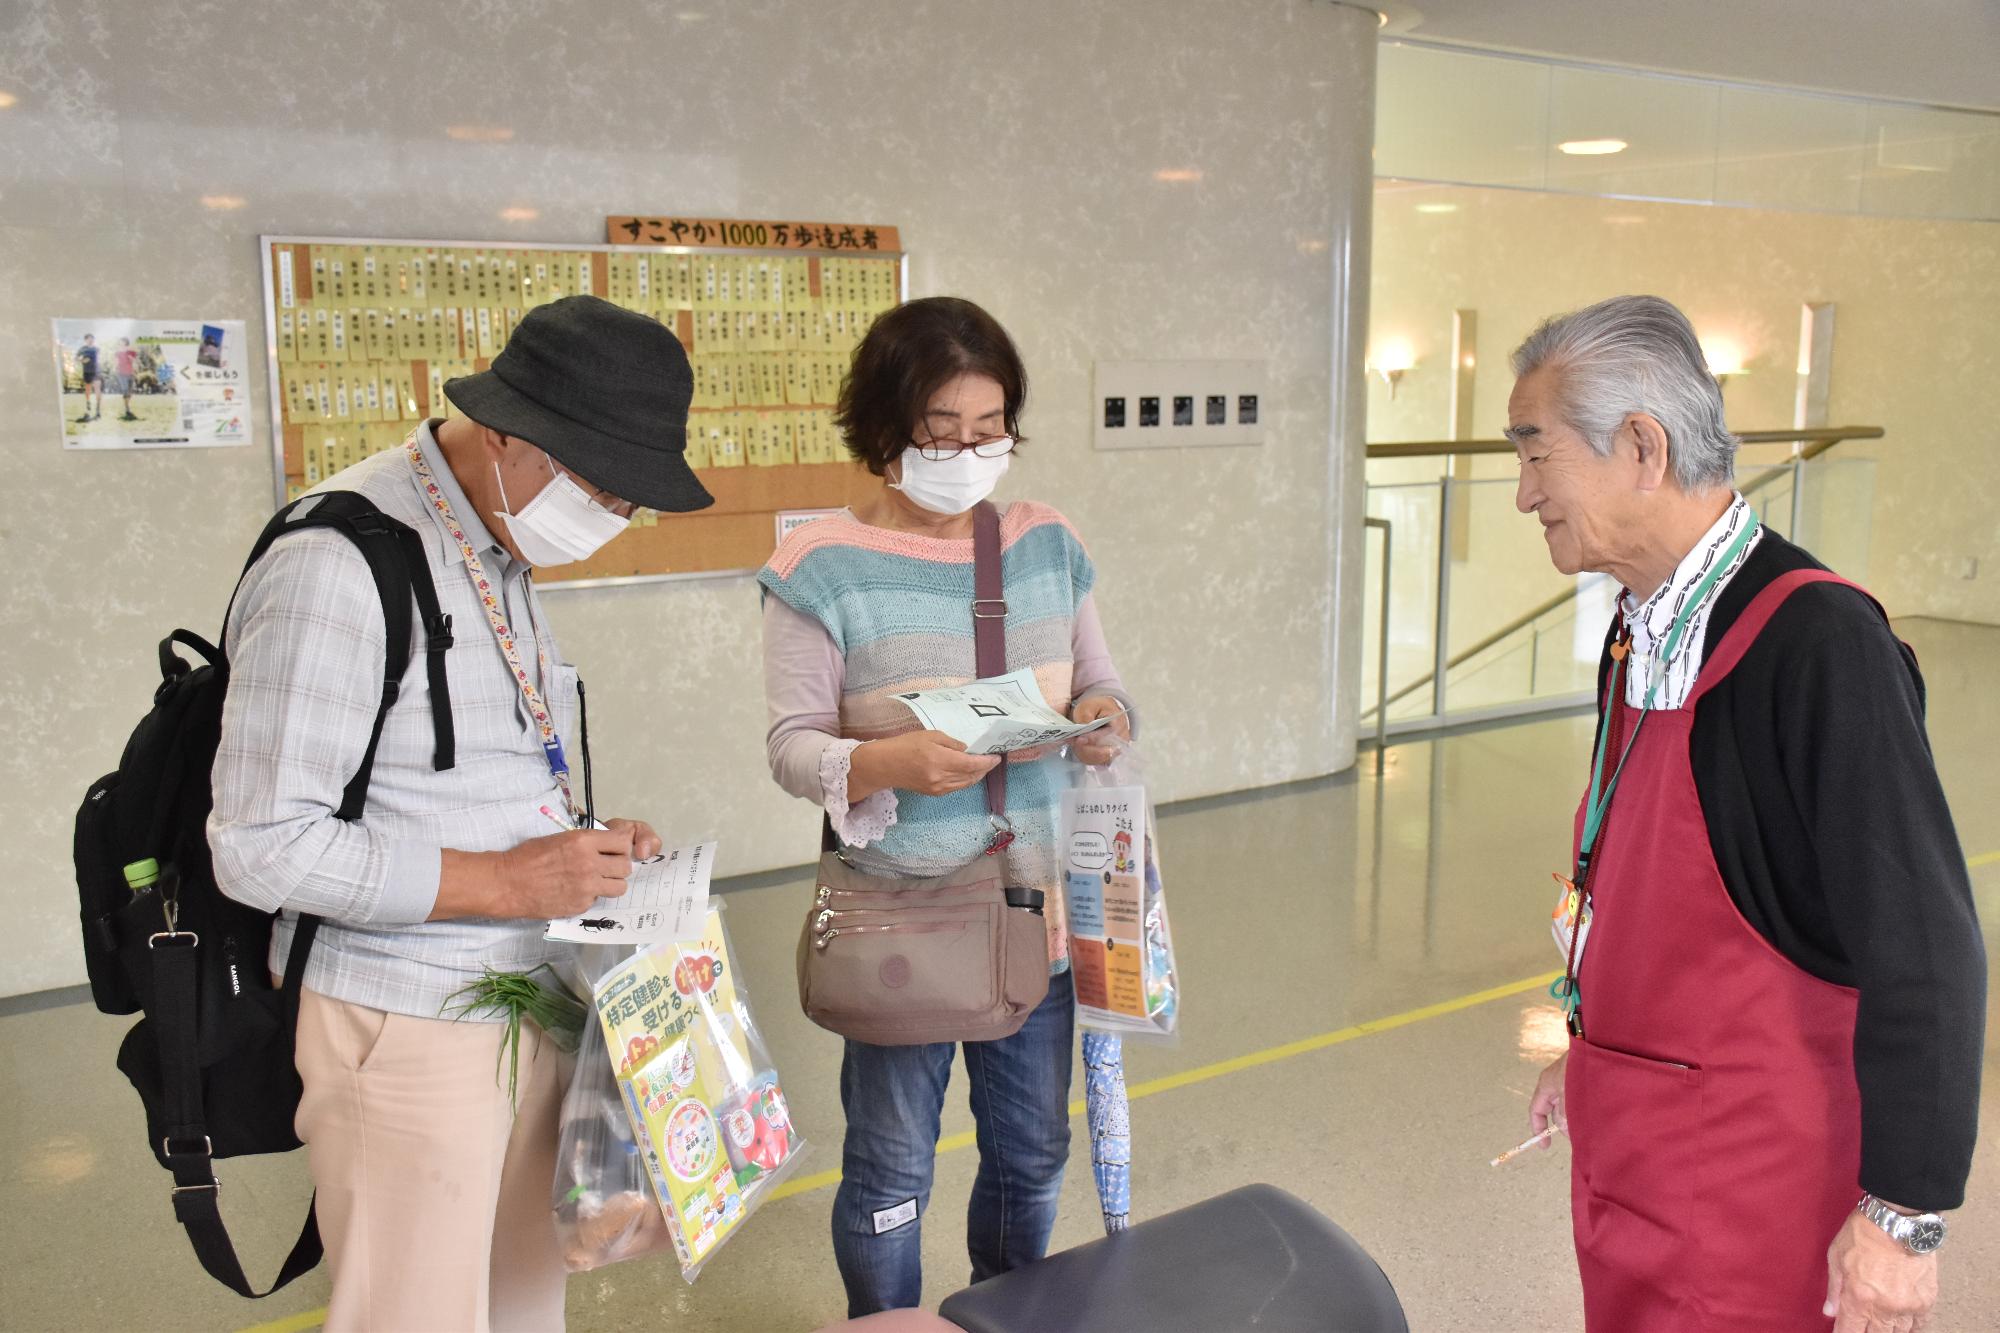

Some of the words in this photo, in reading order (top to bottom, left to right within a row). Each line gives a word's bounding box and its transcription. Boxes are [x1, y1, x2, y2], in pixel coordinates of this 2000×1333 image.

[621, 217, 878, 249] すこやか1000万歩達成者
[230, 964, 241, 995] KANGOL
